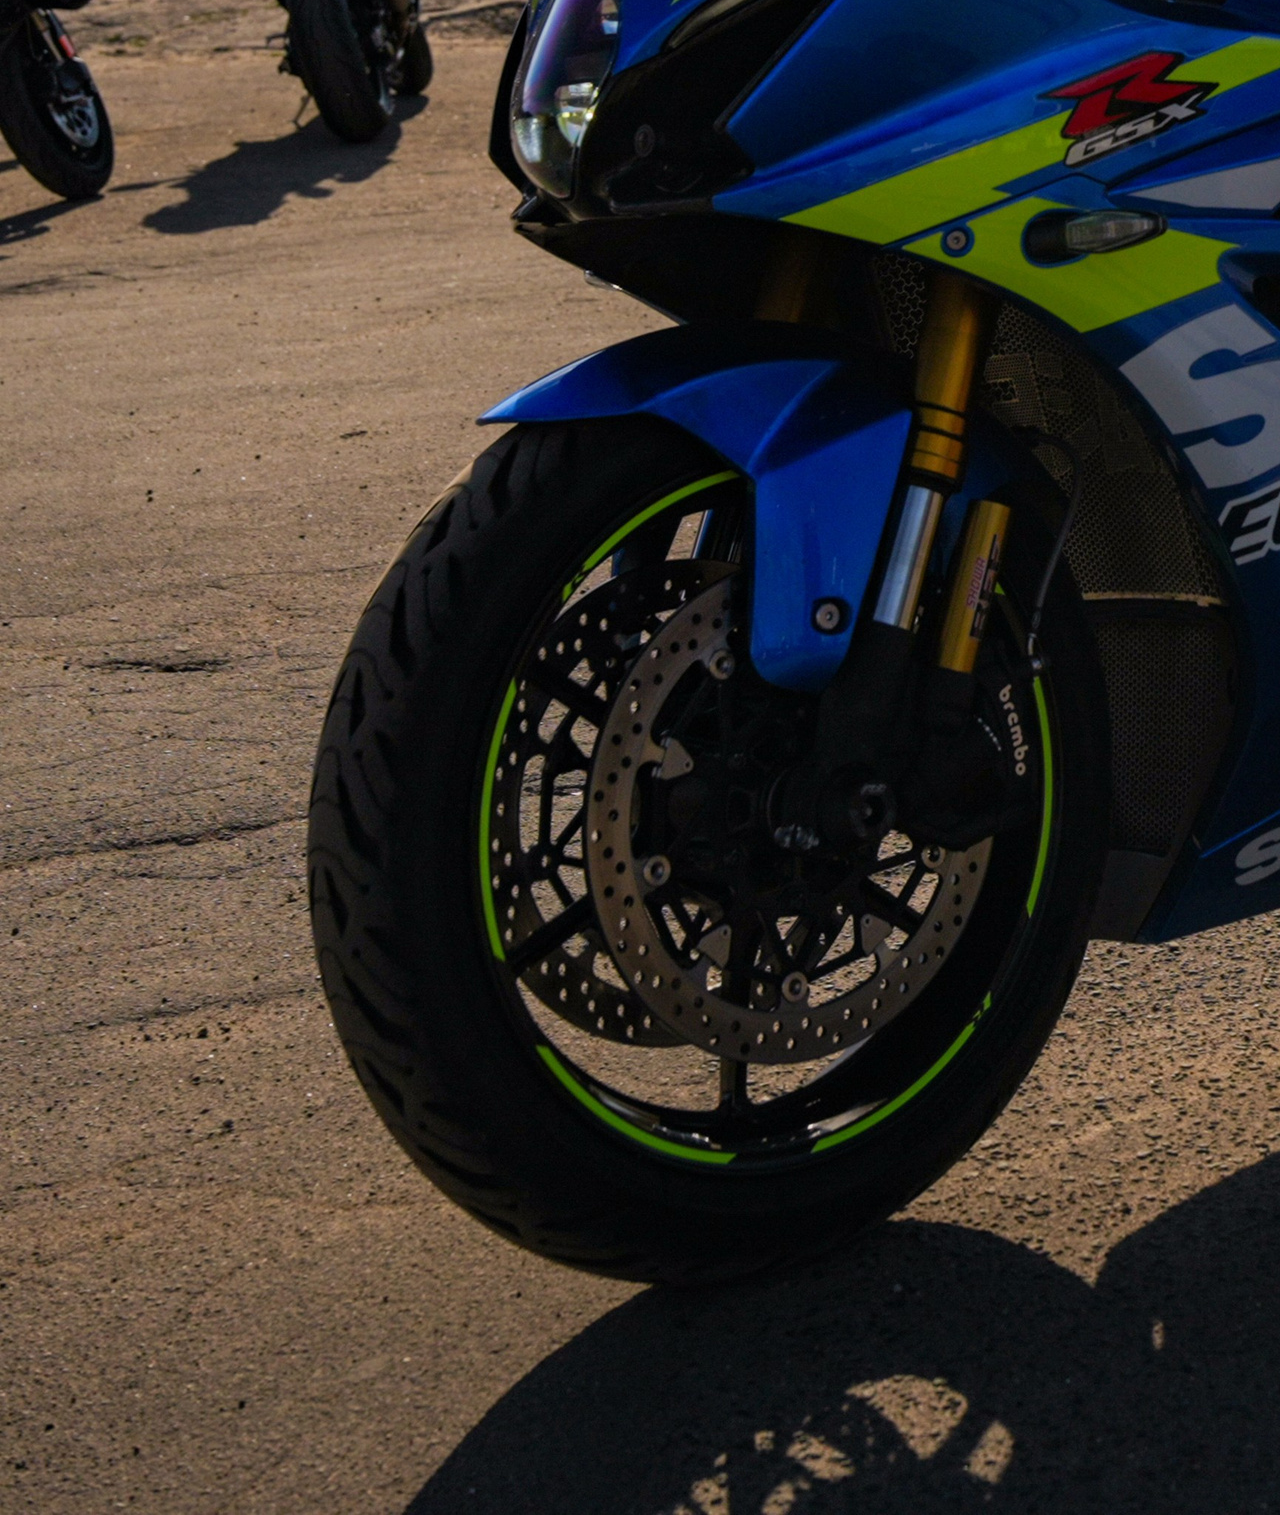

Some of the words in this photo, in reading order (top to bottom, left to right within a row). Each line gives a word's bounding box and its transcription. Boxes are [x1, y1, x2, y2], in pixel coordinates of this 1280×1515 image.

[1065, 91, 1204, 166] GSX
[966, 557, 987, 607] SHOWA
[998, 683, 1029, 776] brembo
